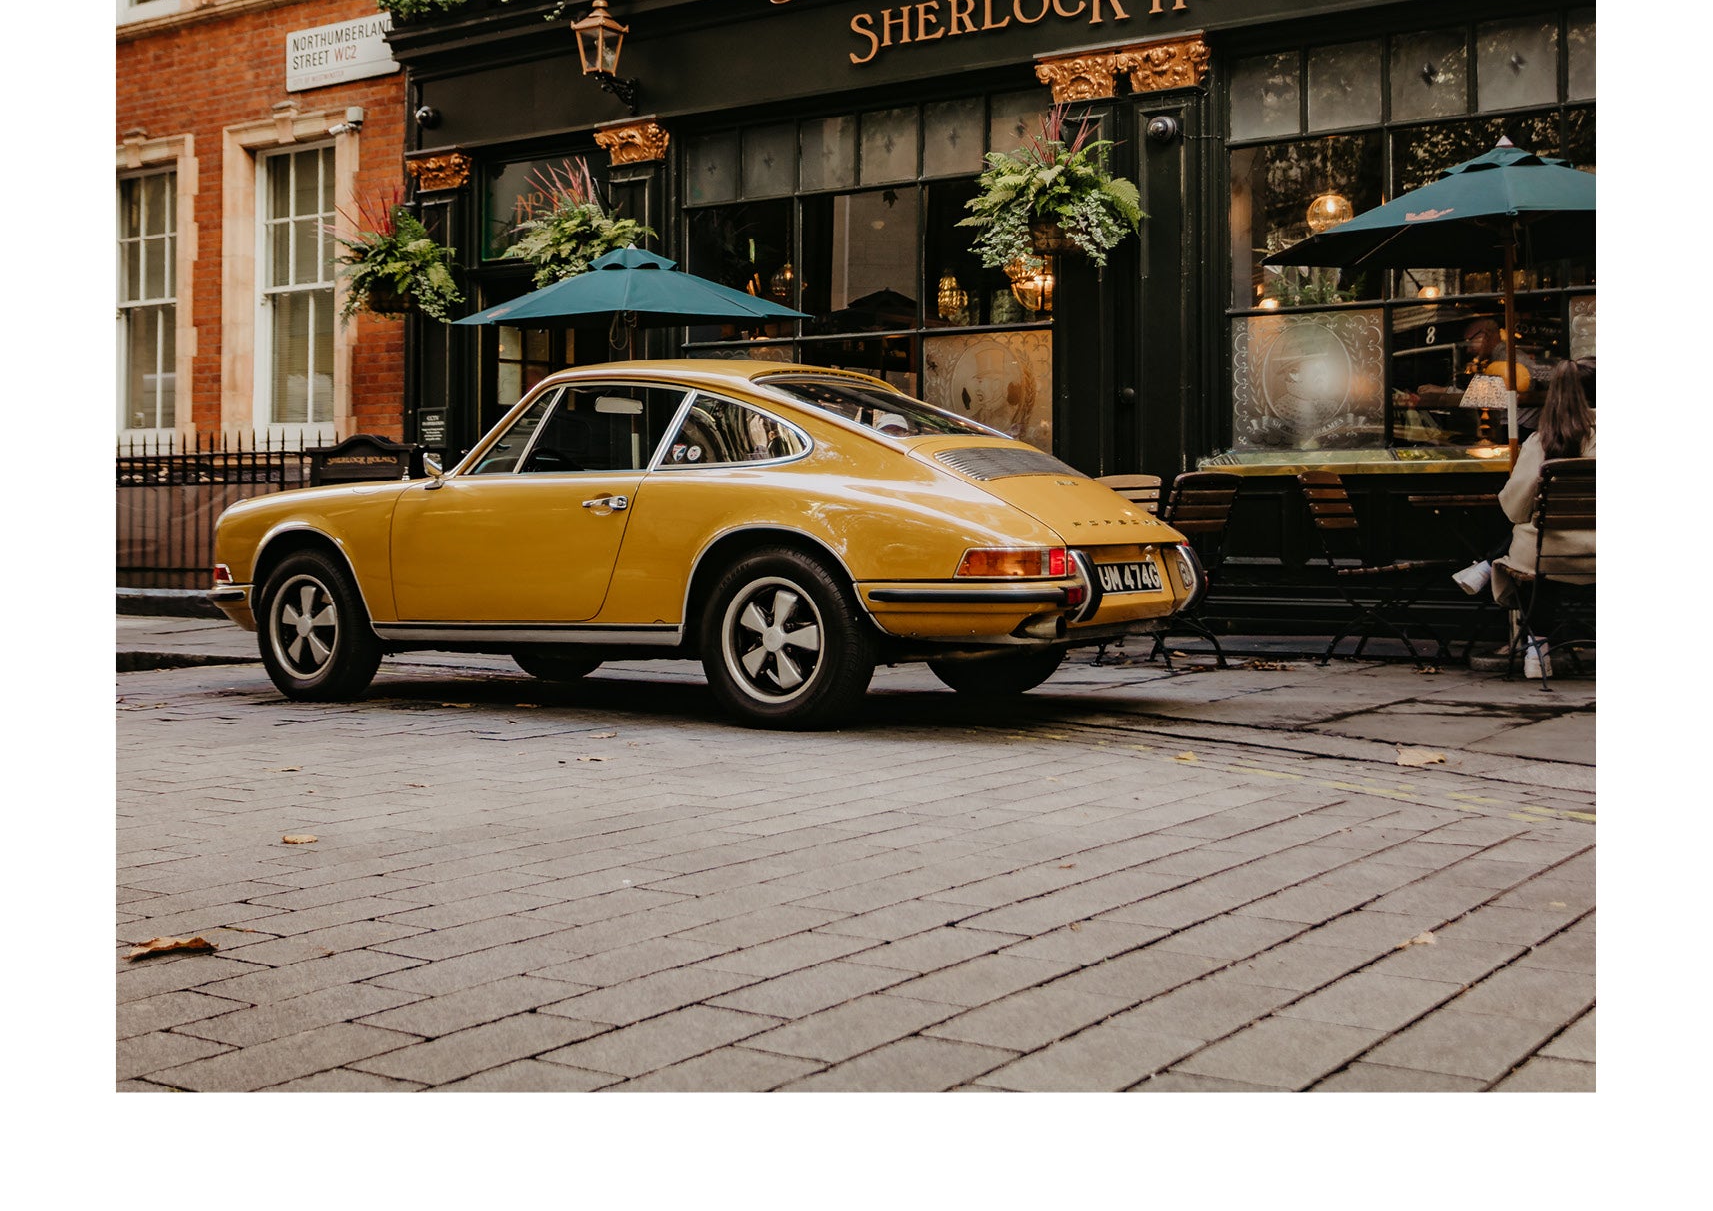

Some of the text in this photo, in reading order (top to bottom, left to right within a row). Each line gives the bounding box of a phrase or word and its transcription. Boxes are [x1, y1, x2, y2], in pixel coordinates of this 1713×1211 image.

[293, 44, 358, 70] STREET WC2
[326, 456, 398, 466] SHERLOCK HOLMES
[1124, 564, 1160, 590] 474G
